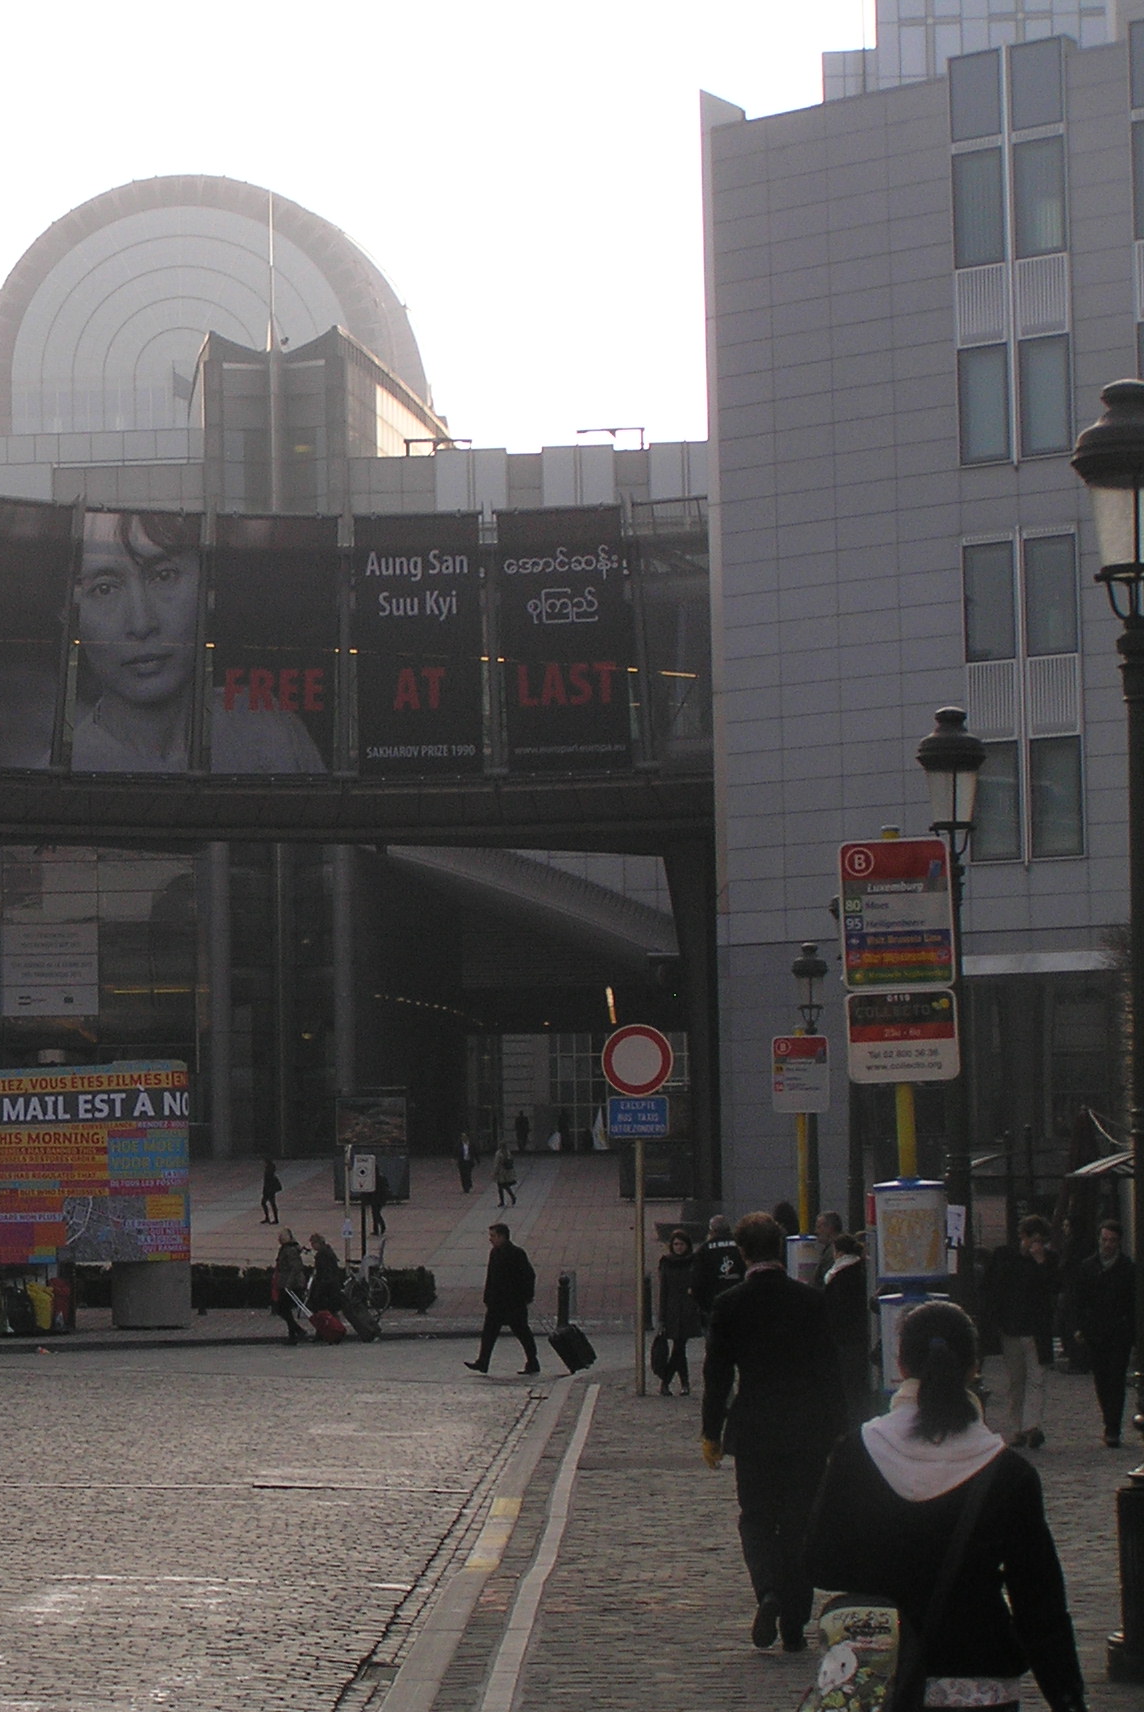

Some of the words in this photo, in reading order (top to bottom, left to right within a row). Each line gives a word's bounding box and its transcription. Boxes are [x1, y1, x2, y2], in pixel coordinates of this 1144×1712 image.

[365, 551, 423, 582] Aung
[428, 549, 469, 576] San
[378, 591, 419, 617] Suu
[425, 590, 458, 621] Kyi
[223, 668, 325, 712] FREE
[393, 667, 447, 711] AT
[516, 661, 617, 707] LAST
[366, 746, 419, 759] SAKHAROV
[421, 745, 448, 757] PRIZE
[451, 744, 476, 757] 1990
[854, 853, 866, 871] B
[866, 882, 924, 893] Luxemburg
[844, 899, 862, 912] 80
[845, 917, 863, 930] 95
[855, 1004, 931, 1018] COLLECTO
[30, 1075, 67, 1091] VOUS
[71, 1073, 104, 1089] ÊTES
[107, 1069, 162, 1088] FILMÉS
[2, 1095, 71, 1122] MAIL
[78, 1092, 127, 1119] EST
[133, 1084, 155, 1117] À
[616, 1113, 633, 1122] BUS
[27, 1130, 105, 1145] MORNING:
